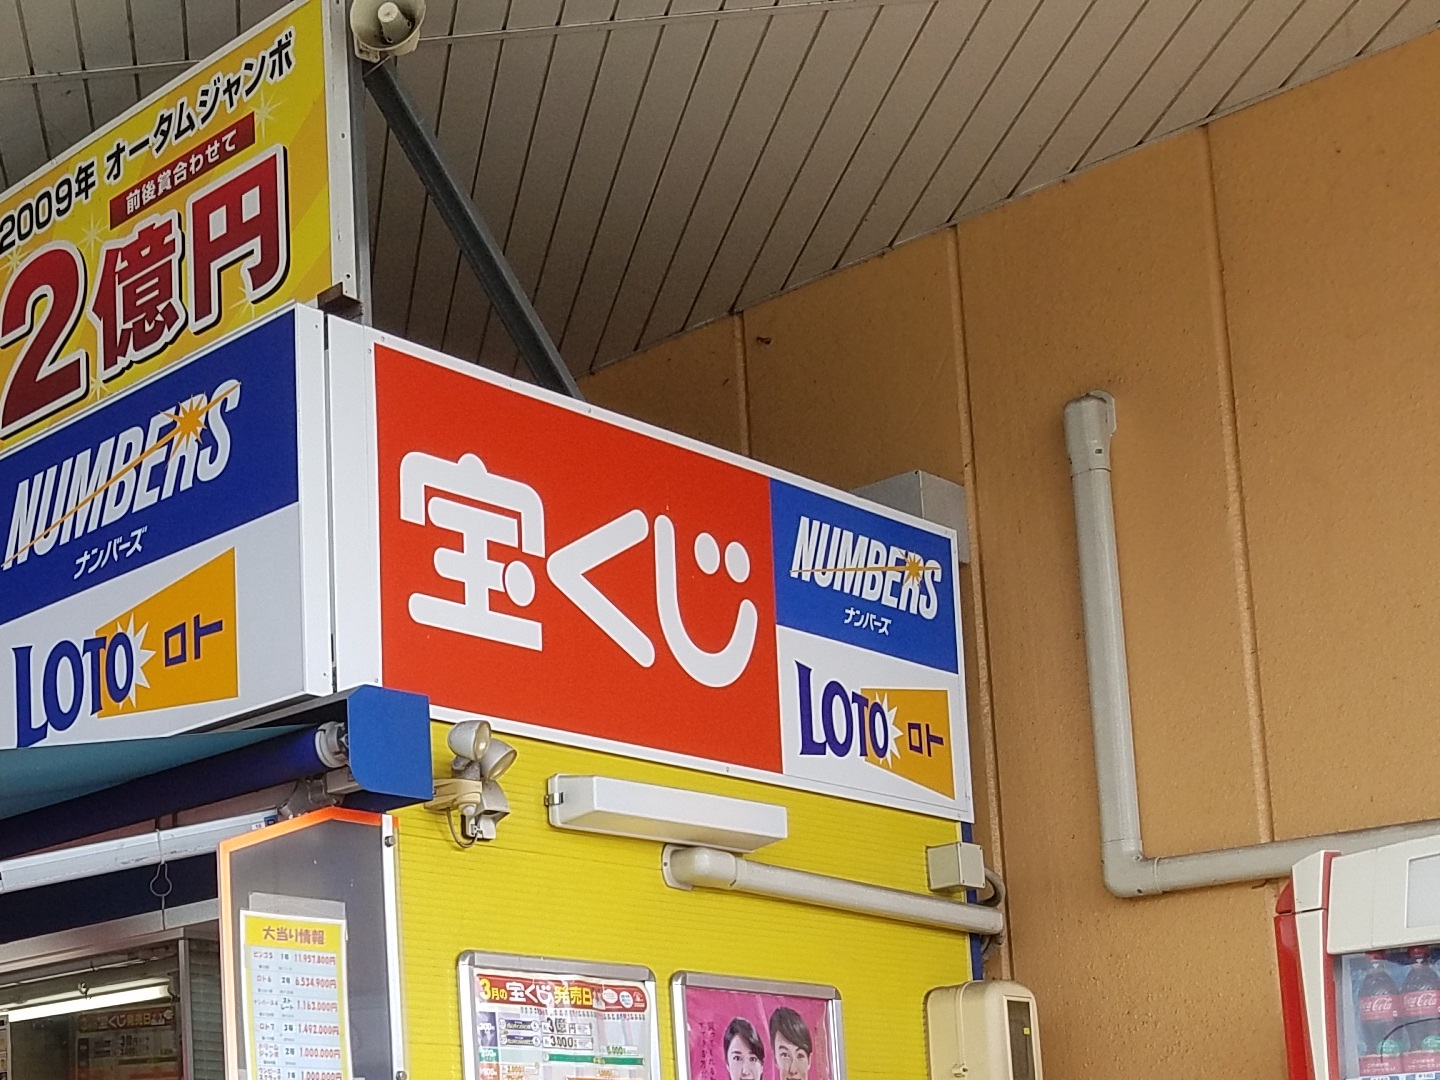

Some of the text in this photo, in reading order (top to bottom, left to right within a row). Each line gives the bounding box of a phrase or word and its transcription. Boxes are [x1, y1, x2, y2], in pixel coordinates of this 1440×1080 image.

[0, 165, 97, 256] 2009年
[103, 31, 296, 183] オータムジャンボ
[125, 129, 237, 214] 前後賞合わせて
[1, 380, 241, 570] NUMBERS
[73, 526, 149, 581] ナンバーズ
[400, 452, 758, 687] 宝くじ
[790, 516, 941, 620] NUMBERS
[163, 614, 223, 668] ロト
[845, 606, 891, 636] ナンバーズ
[12, 630, 134, 749] LOTO
[795, 661, 888, 758] LOTO
[907, 722, 944, 757] ロト
[263, 926, 324, 945] 大当り情報
[479, 978, 594, 1006] 3月の宝くじ発売日
